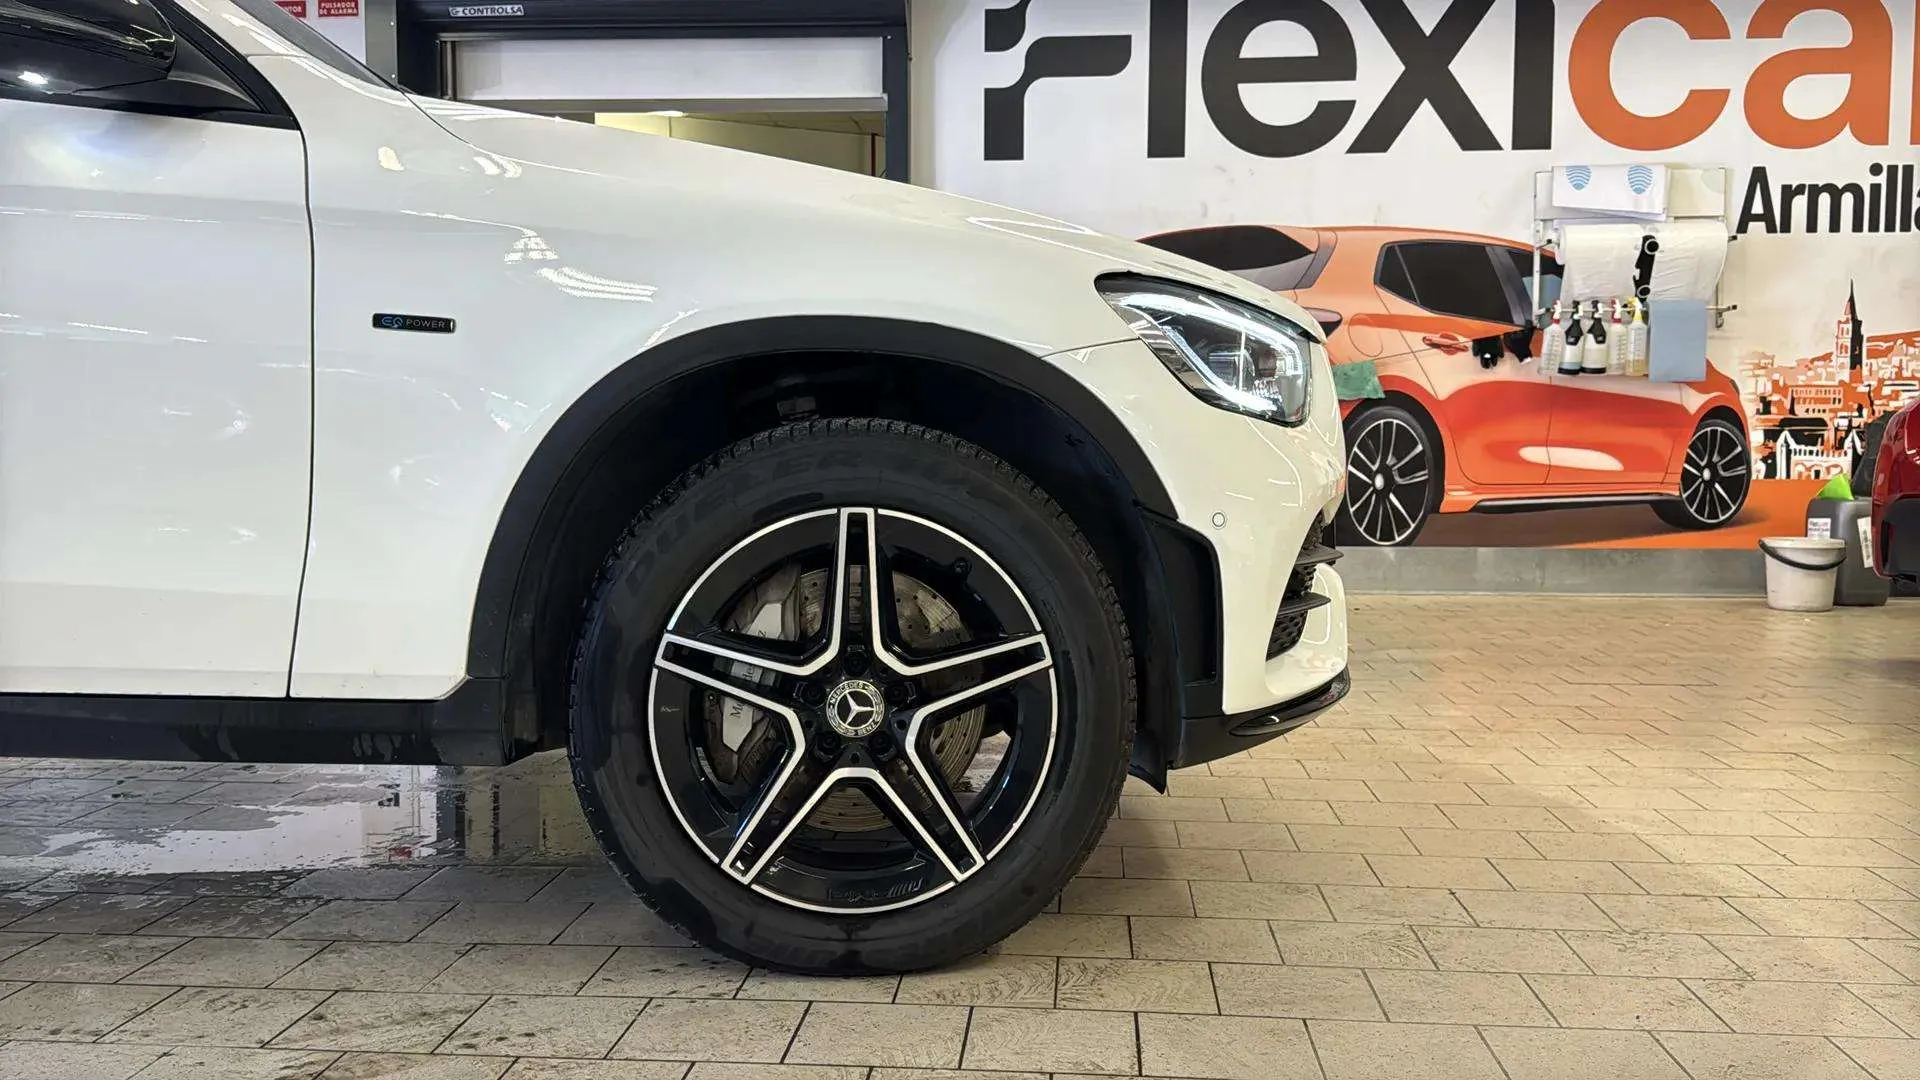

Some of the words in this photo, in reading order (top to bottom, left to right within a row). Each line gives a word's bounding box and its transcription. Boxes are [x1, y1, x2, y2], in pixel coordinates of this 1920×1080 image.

[462, 6, 523, 15] CONTROLSA
[984, 0, 1920, 160] Flexica
[1735, 162, 1920, 234] Armill
[405, 319, 446, 329] POWER
